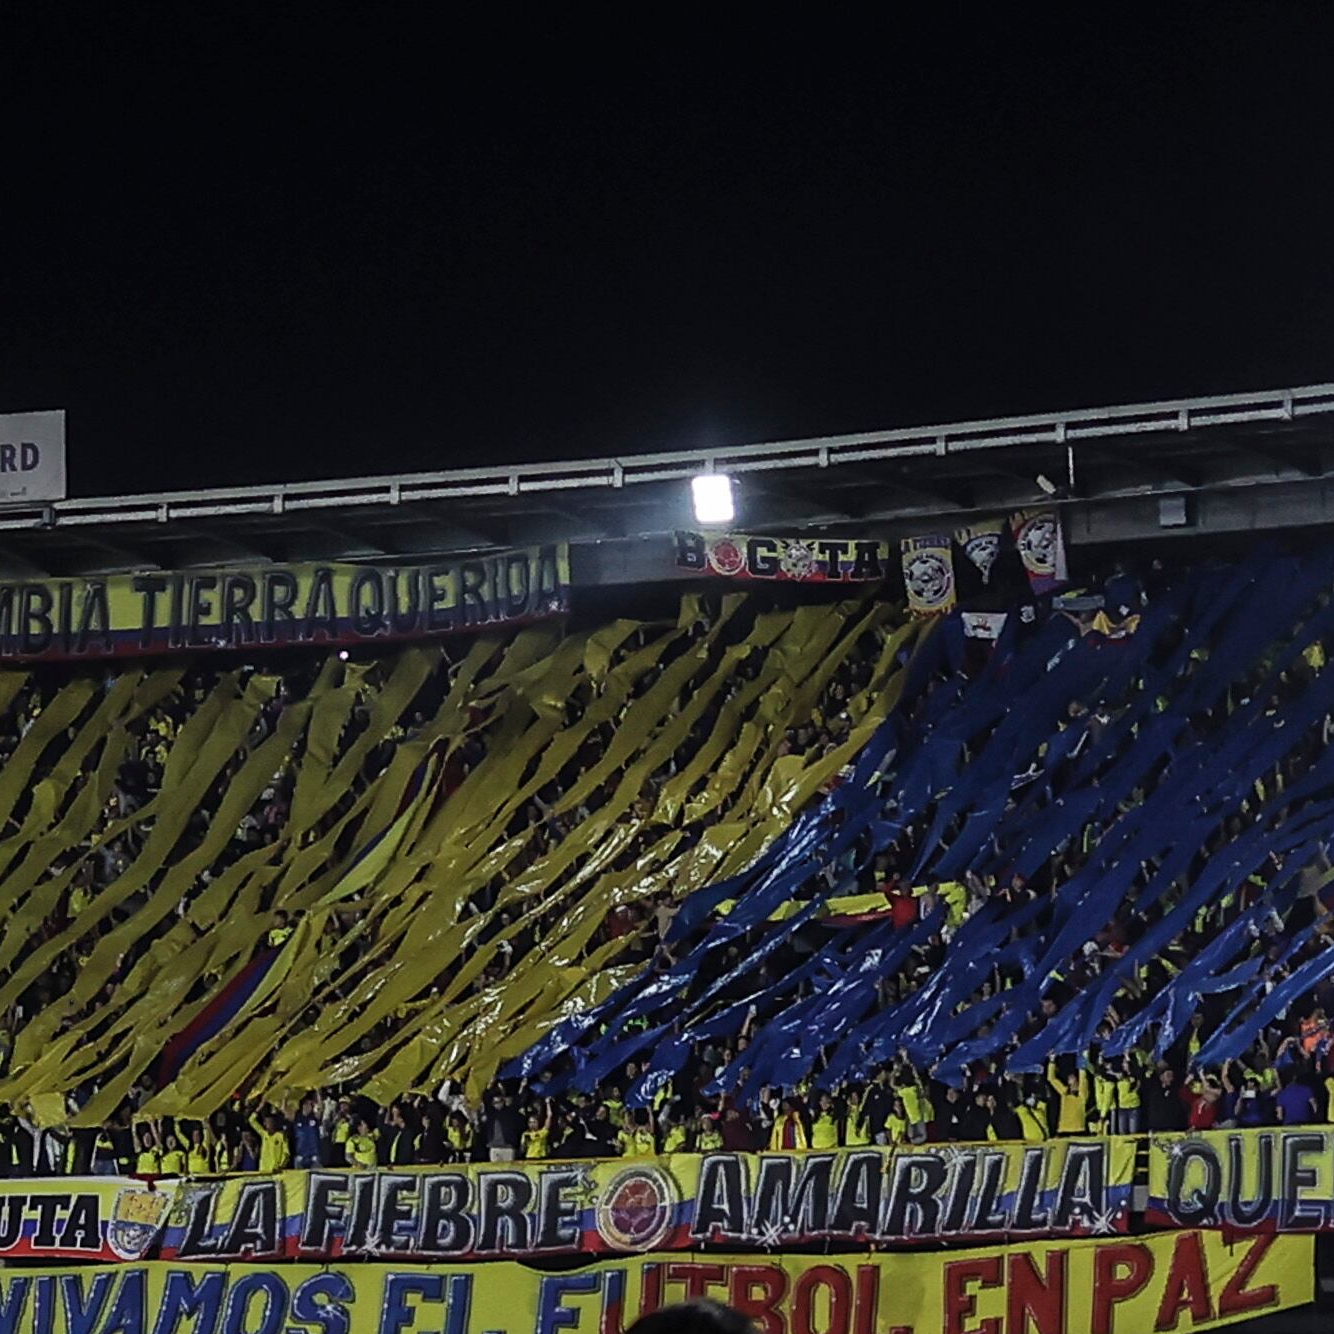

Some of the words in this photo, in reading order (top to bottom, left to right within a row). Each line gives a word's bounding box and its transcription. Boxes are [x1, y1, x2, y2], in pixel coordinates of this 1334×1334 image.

[132, 565, 339, 650] TIERRA
[348, 545, 567, 637] QUERIDA
[178, 1178, 283, 1257] LA
[299, 1165, 585, 1257] FIEBRE
[689, 1141, 1111, 1242] AMARILLA
